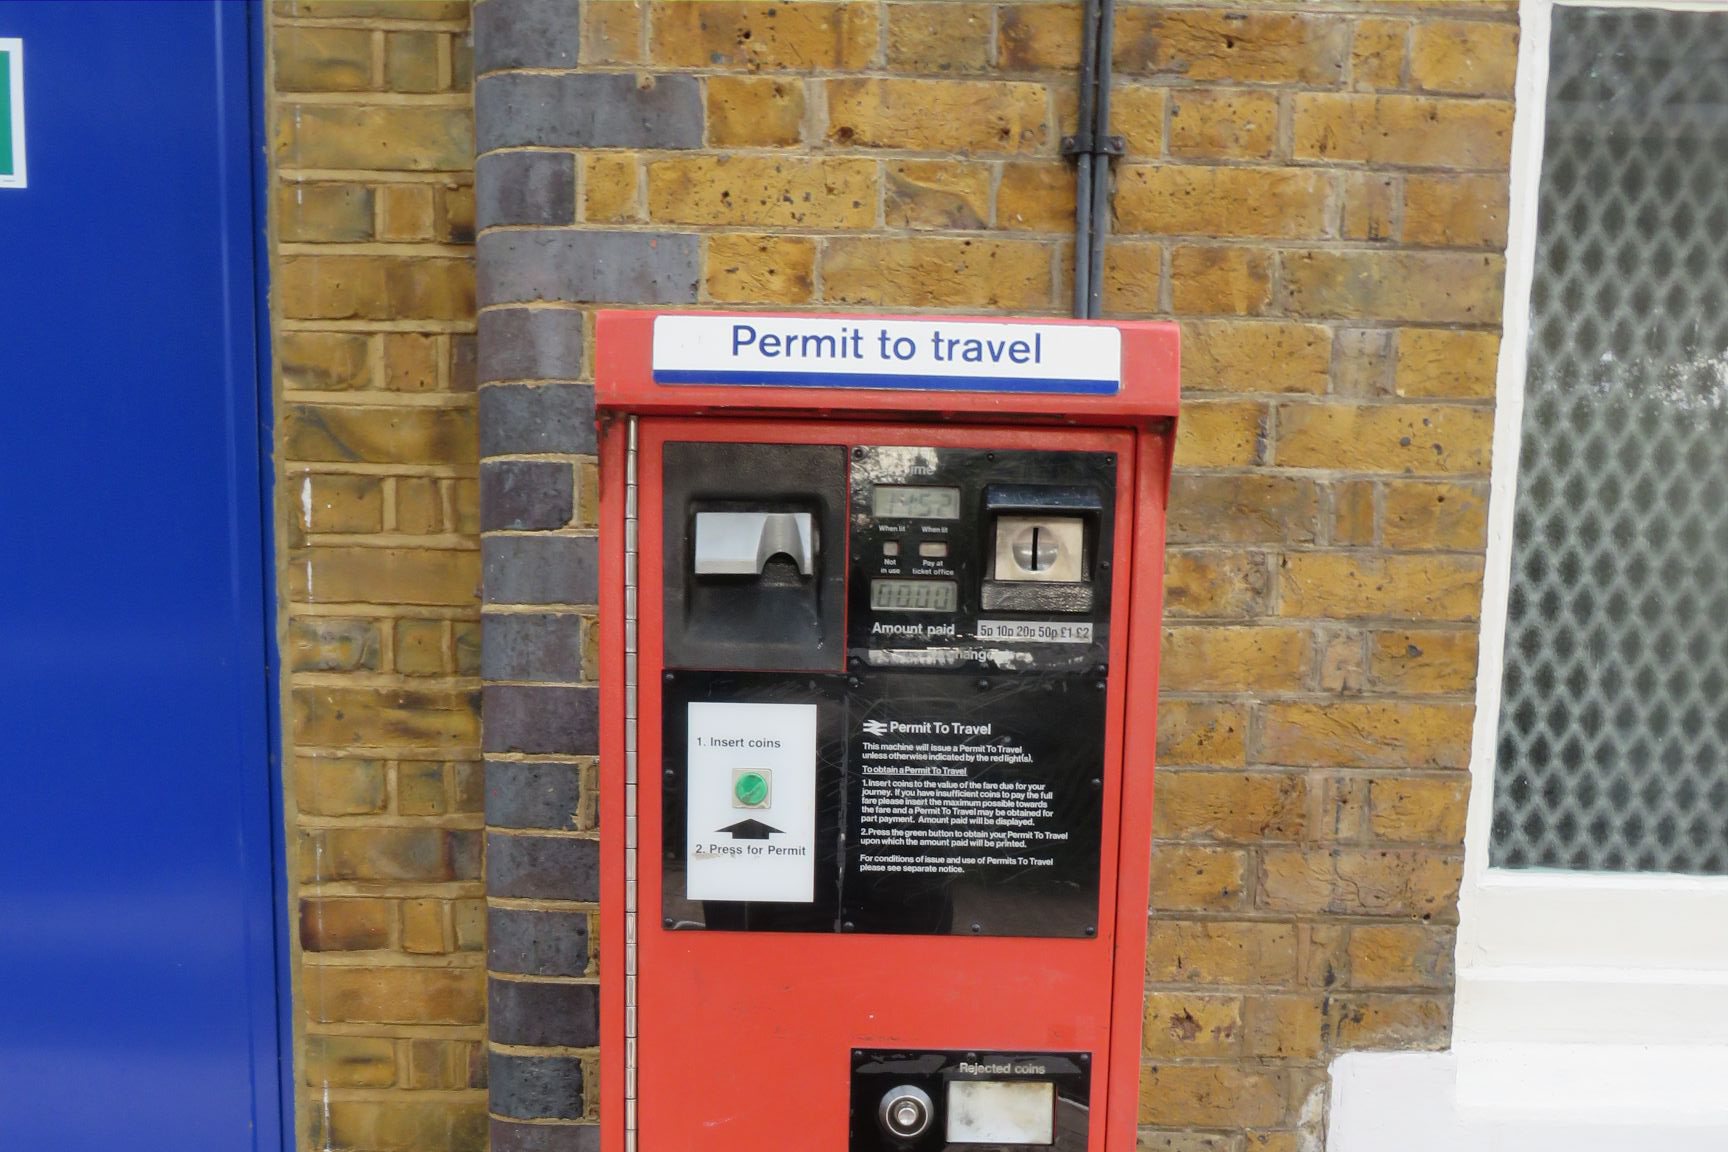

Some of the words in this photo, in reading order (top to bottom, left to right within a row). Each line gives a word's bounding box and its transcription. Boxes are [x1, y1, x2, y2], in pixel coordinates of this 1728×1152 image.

[732, 325, 864, 359] Permit
[877, 329, 916, 361] to
[932, 331, 1041, 364] travel
[872, 622, 923, 634] Amount
[927, 624, 955, 638] paid
[980, 625, 993, 637] 5p
[996, 625, 1014, 636] 10p
[1016, 626, 1035, 637] 20p
[1038, 626, 1057, 640] 50p
[1061, 627, 1072, 638] £1
[1076, 627, 1089, 638] £2
[890, 722, 931, 733] Permit
[933, 722, 949, 734] To
[951, 722, 992, 735] Travel
[696, 738, 706, 746] 1.
[710, 738, 744, 747] Insert
[748, 738, 781, 748] coins
[966, 754, 975, 762] by
[1004, 754, 1033, 763] light(s).
[905, 766, 930, 774] Permit
[942, 767, 967, 775] Travel
[862, 788, 893, 797] journey.
[936, 789, 979, 797] insufficient
[982, 800, 1015, 808] possible
[879, 816, 915, 824] payment.
[951, 817, 968, 825] paid
[996, 818, 1035, 826] displayed.
[951, 839, 968, 847] paid
[996, 840, 1027, 848] printed.
[695, 844, 705, 854] 2.
[710, 844, 742, 854] Press
[747, 845, 763, 855] for
[768, 845, 806, 856] Permit
[860, 864, 886, 872] please
[960, 1063, 1010, 1075] Rejected
[1015, 1064, 1046, 1074] coins
